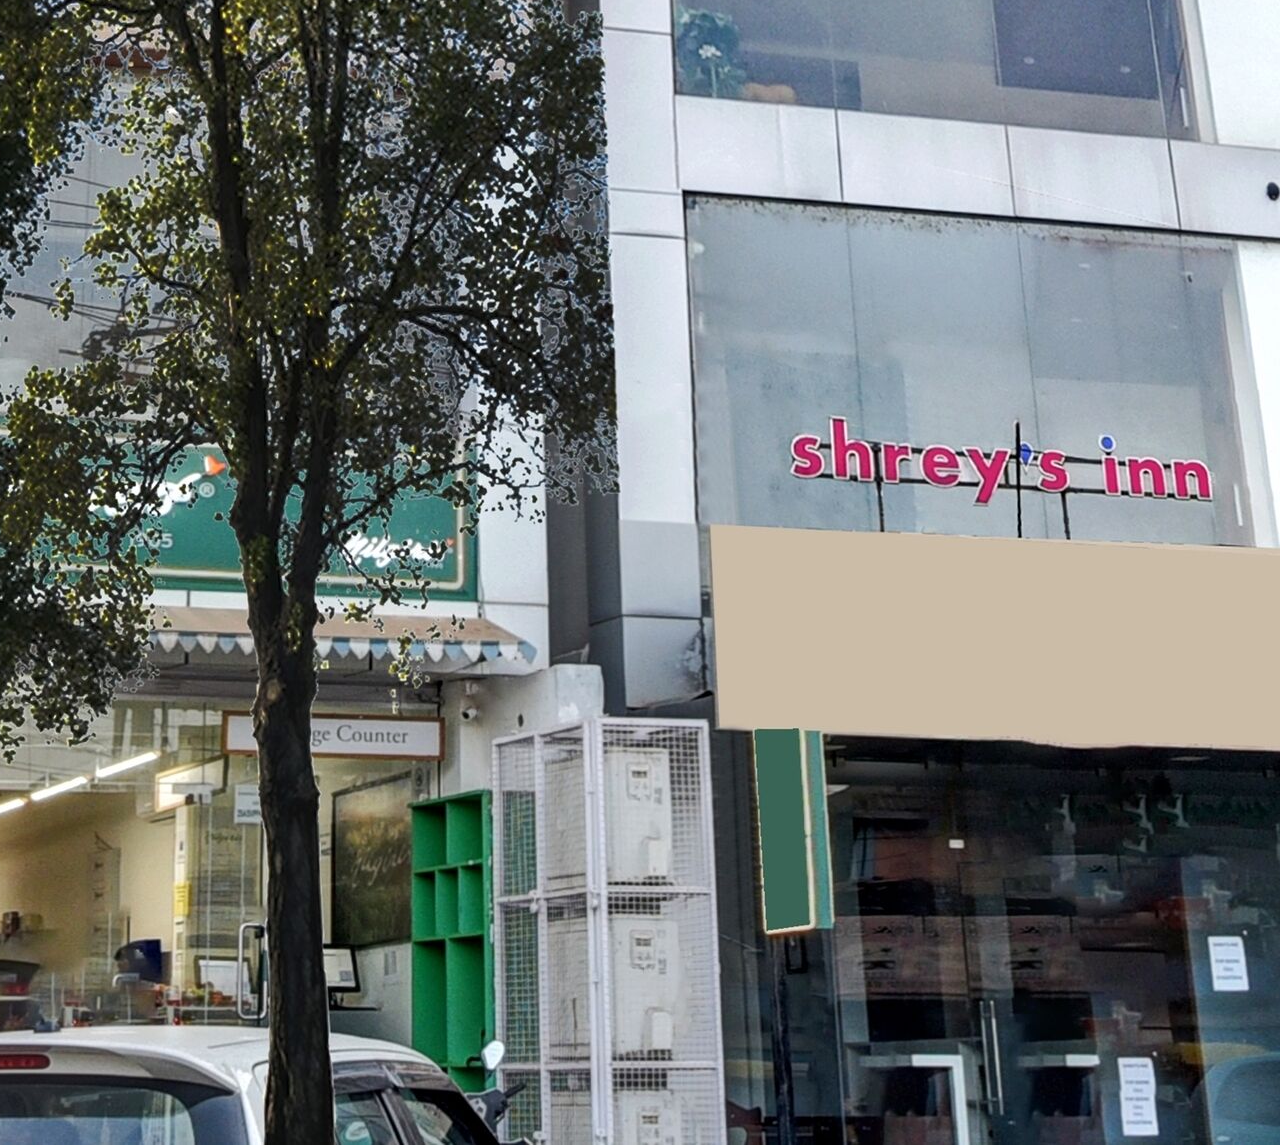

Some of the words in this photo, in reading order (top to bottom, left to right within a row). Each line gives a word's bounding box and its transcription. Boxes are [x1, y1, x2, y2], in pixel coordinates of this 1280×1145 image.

[789, 415, 1070, 506] shrey's
[1099, 434, 1214, 500] inn
[336, 724, 409, 744] Counter
